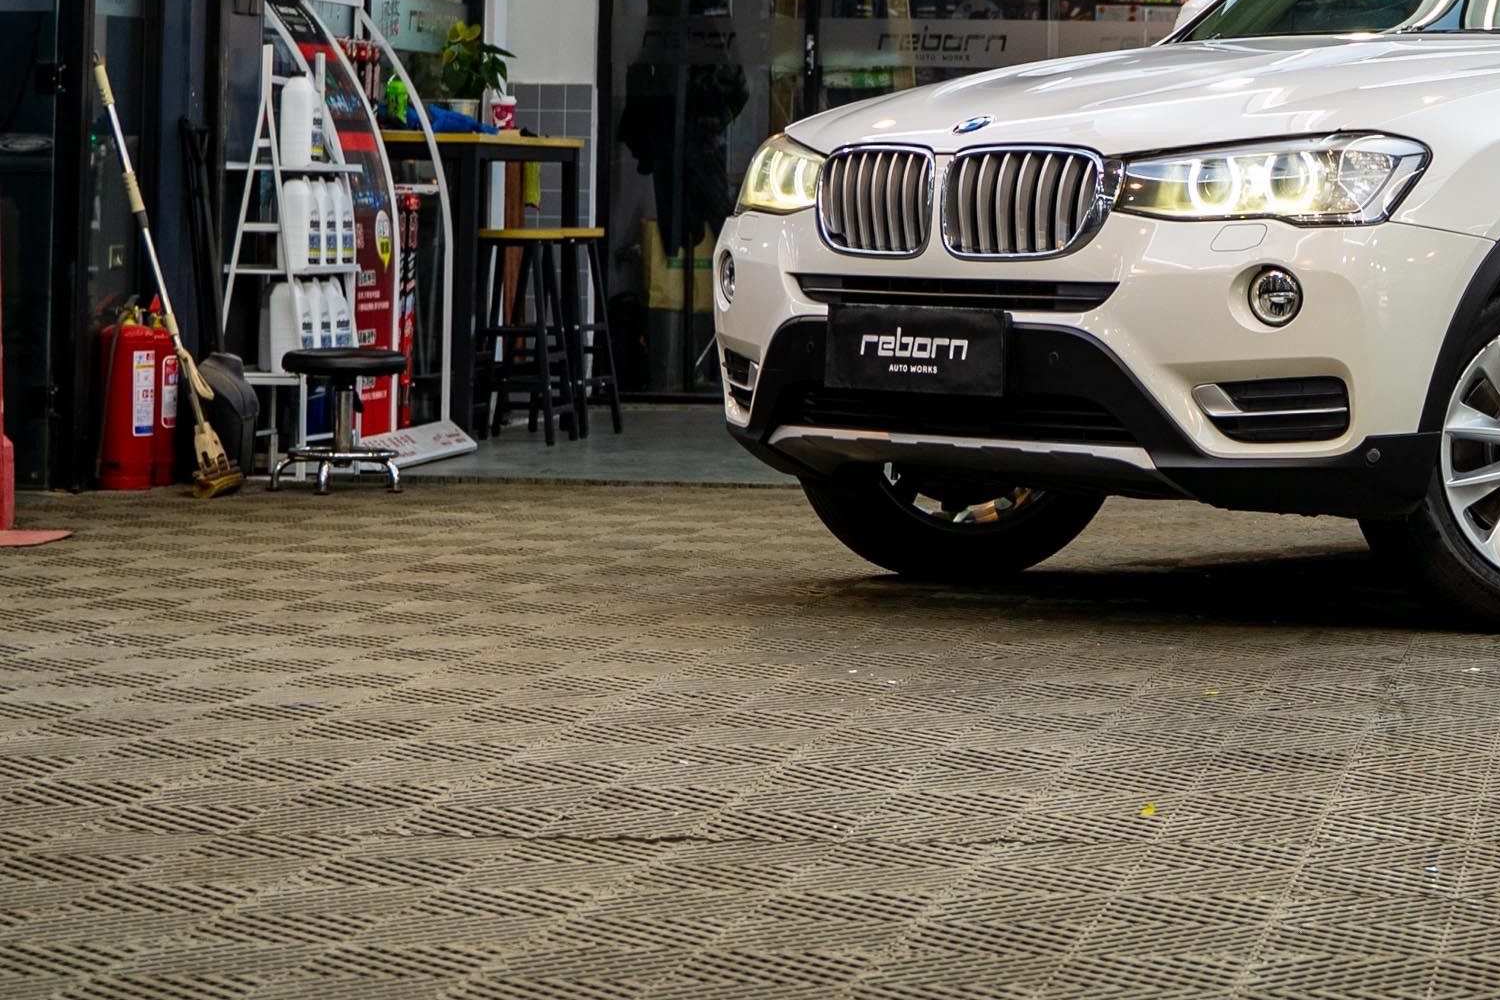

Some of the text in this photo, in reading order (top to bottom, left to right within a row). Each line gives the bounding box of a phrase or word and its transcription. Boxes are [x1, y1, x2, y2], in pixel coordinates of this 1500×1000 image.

[859, 326, 969, 361] reborn
[888, 364, 938, 375] AUTO WORKS
